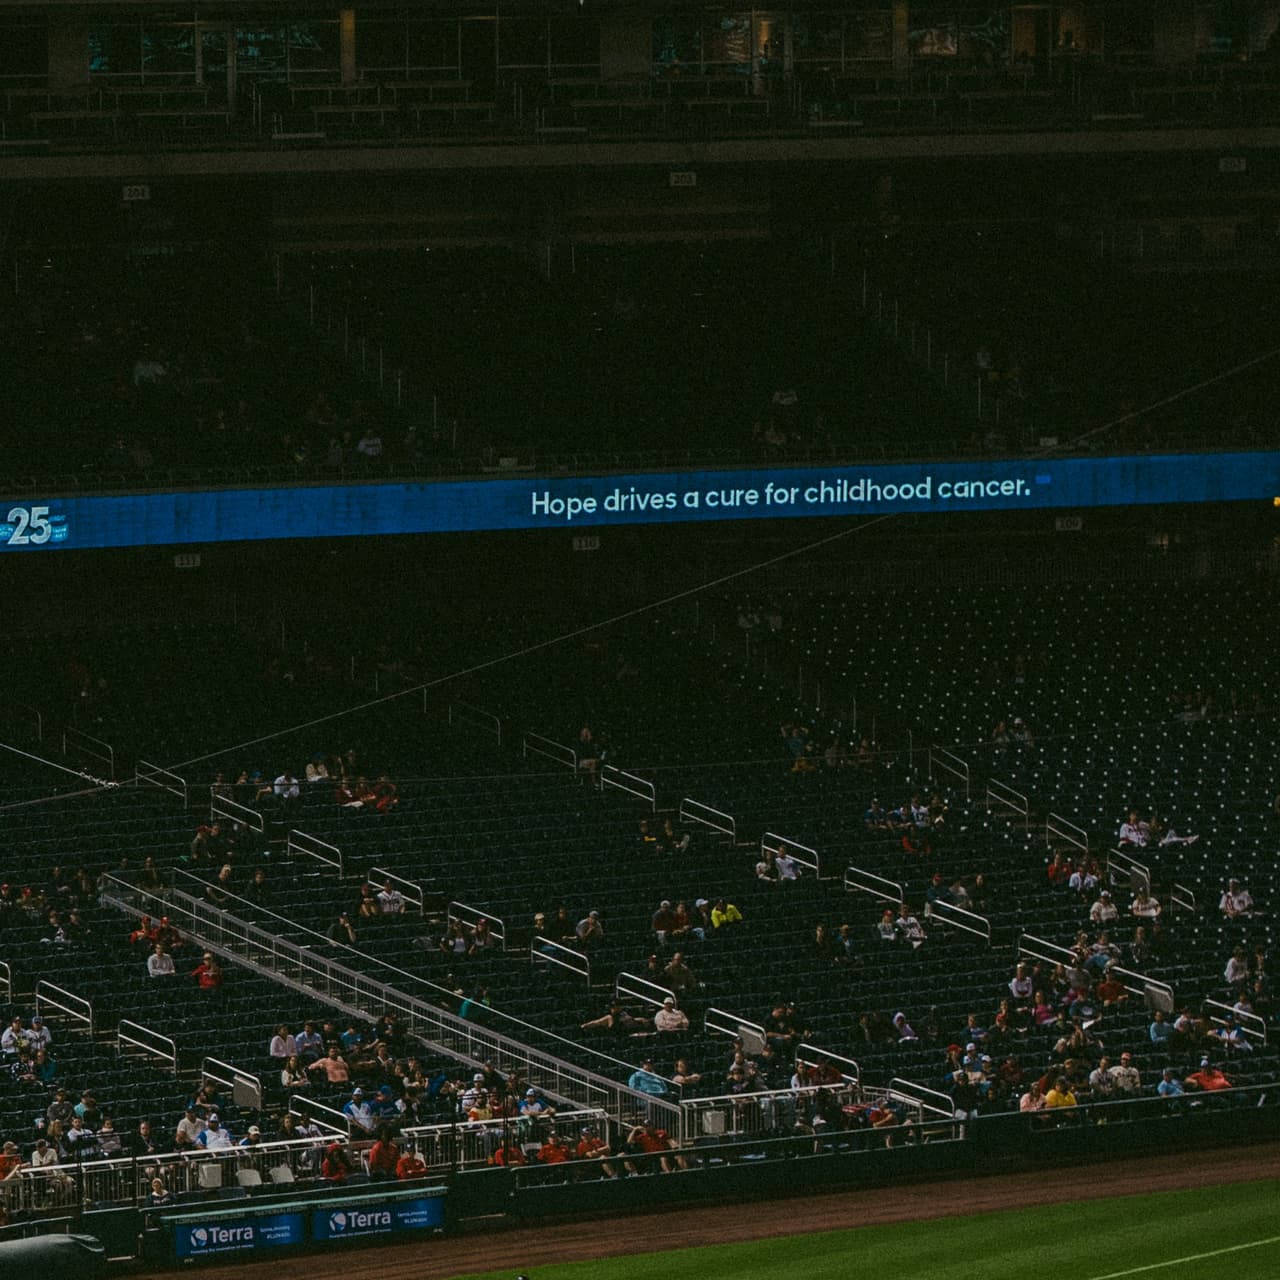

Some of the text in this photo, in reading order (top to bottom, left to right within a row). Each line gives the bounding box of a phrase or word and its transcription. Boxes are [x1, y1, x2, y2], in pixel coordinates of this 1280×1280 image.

[531, 475, 1032, 519] Hope drives a cure for childhood cancer.
[7, 506, 52, 545] 25
[347, 1211, 391, 1228] Terra
[208, 1226, 254, 1243] Terra
